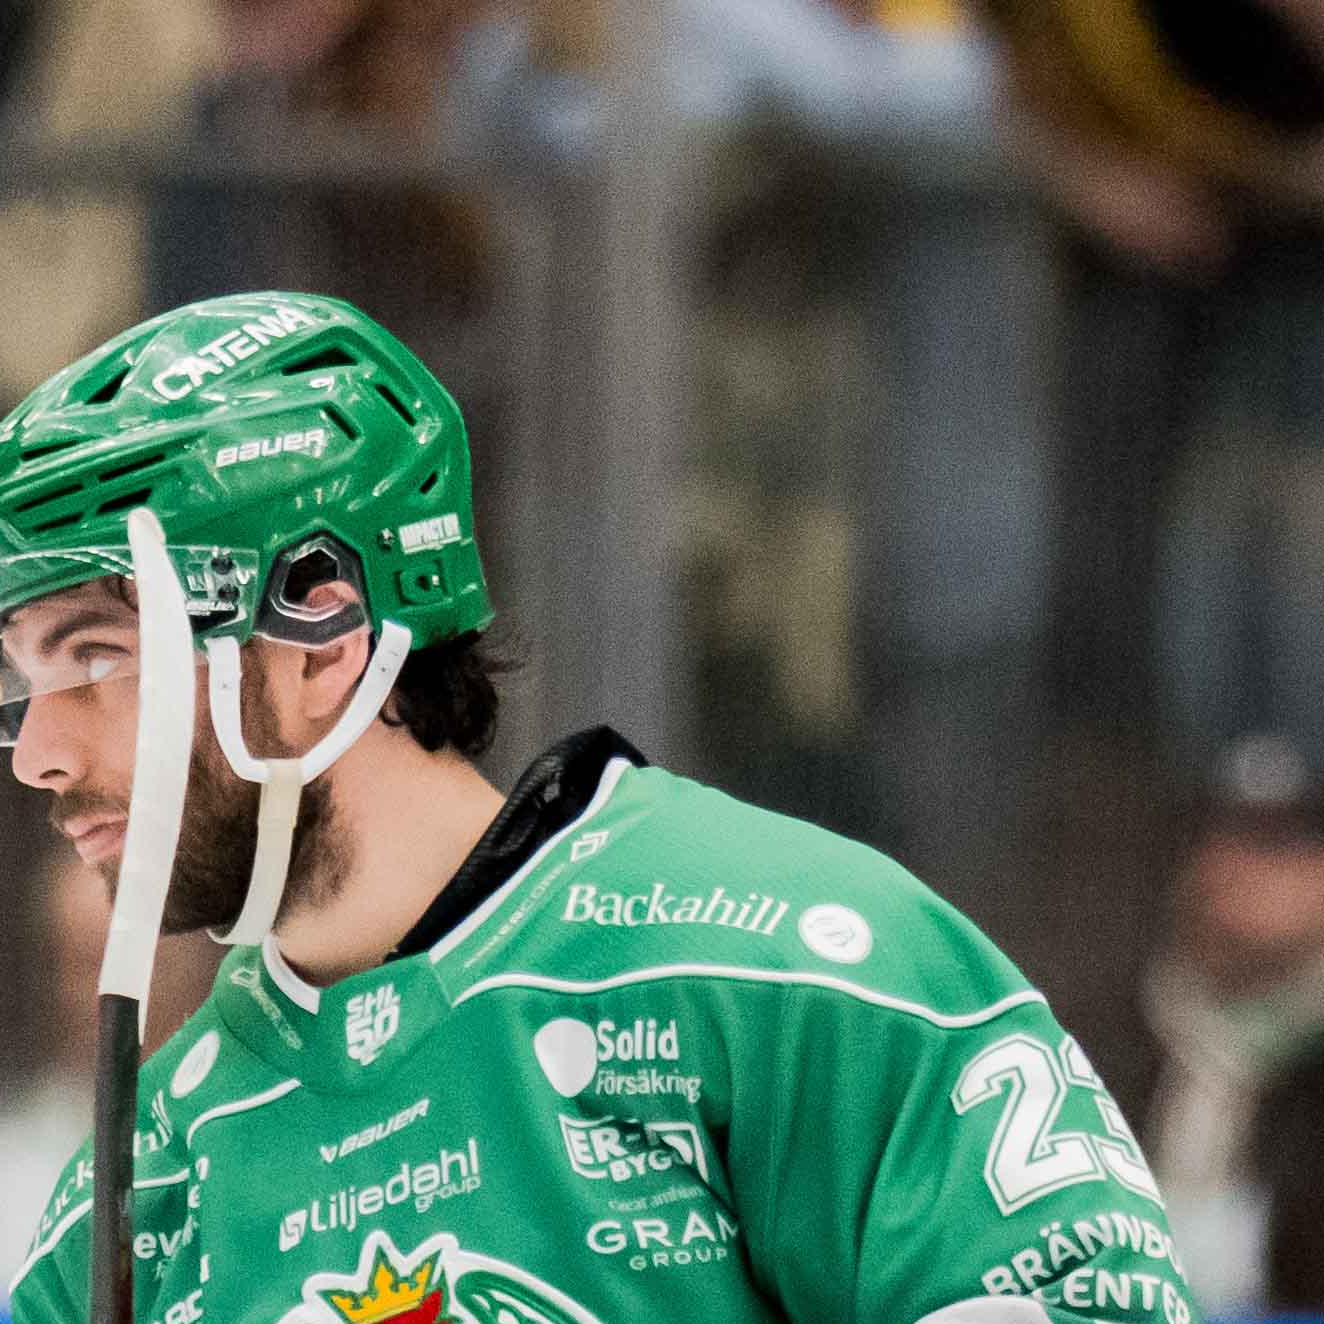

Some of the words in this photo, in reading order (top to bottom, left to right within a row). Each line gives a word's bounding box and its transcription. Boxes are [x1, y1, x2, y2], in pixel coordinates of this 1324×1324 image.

[152, 304, 315, 401] CATENA
[215, 427, 329, 469] BAUER
[560, 883, 790, 937] Backahill
[595, 1018, 680, 1062] Solid
[595, 1068, 702, 1104] Försäkring
[310, 1136, 480, 1232] Liljedahl
[629, 1247, 728, 1271] GROUP
